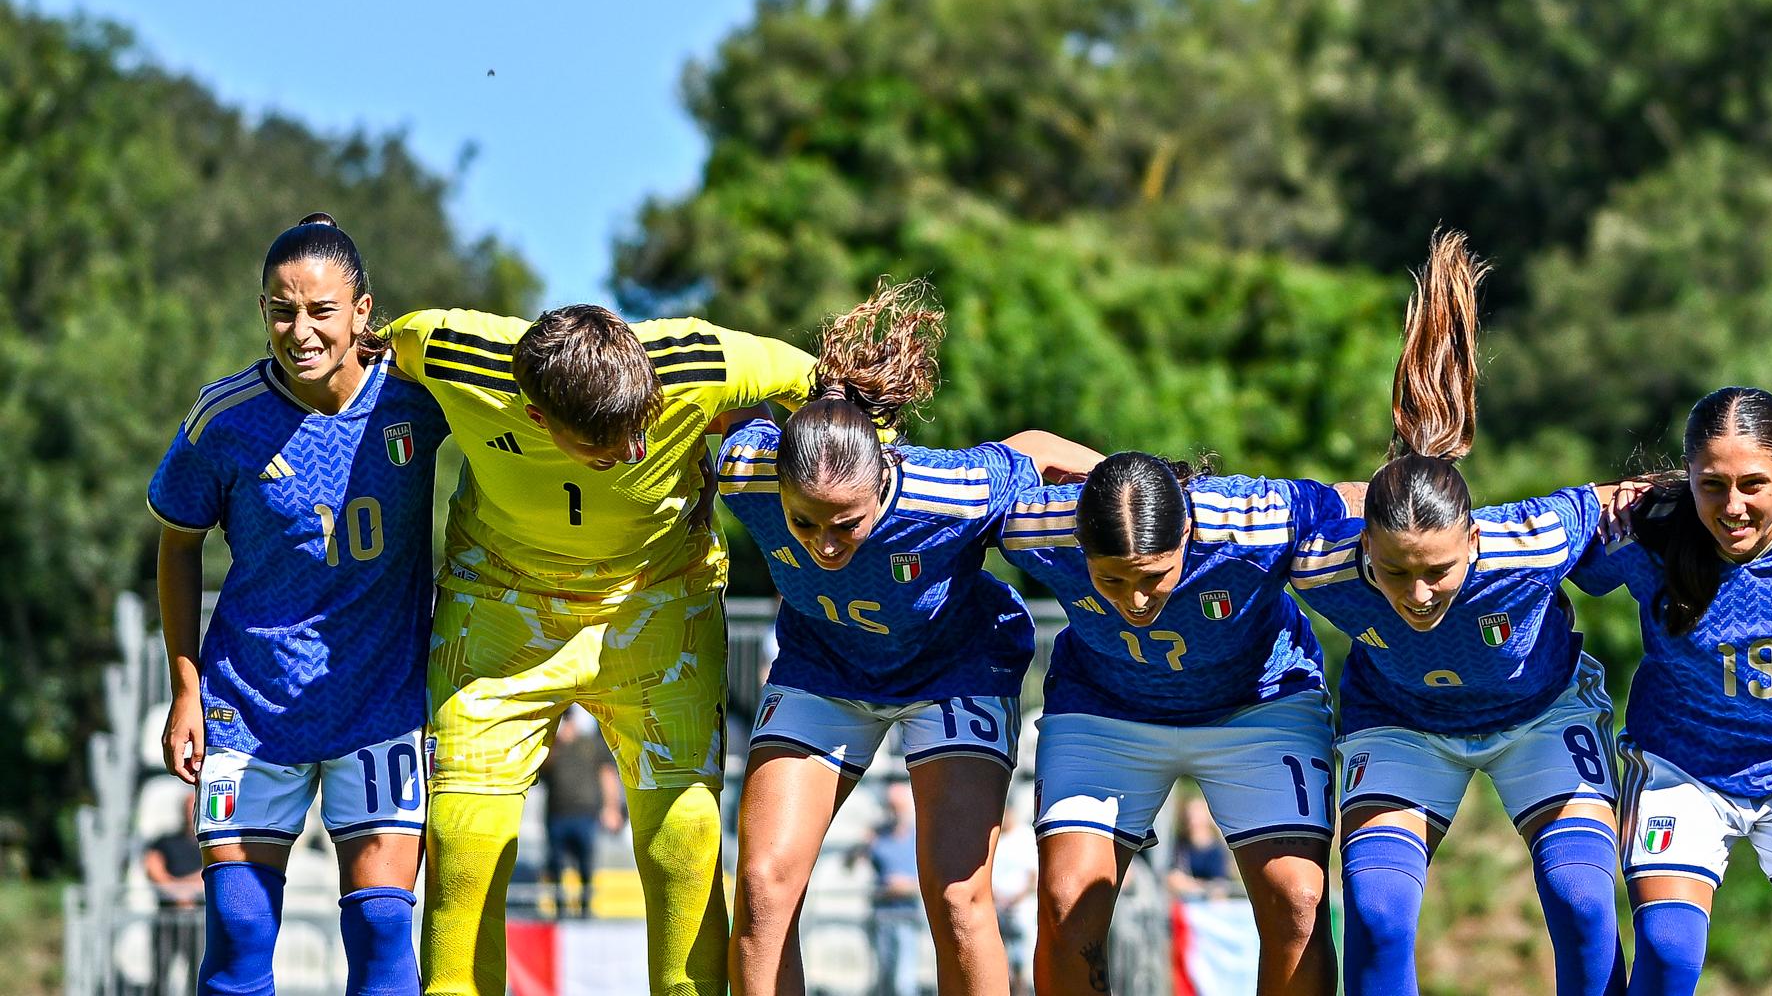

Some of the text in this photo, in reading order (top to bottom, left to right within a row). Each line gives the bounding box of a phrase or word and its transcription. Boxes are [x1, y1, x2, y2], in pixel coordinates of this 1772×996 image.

[386, 426, 409, 438] ITALIA
[563, 482, 582, 525] 1
[314, 497, 384, 566] 10
[893, 555, 917, 563] ITALIA
[1202, 592, 1226, 601] ITALIA
[1482, 615, 1506, 625] ITALIA
[1120, 630, 1187, 671] 17
[937, 697, 999, 742] 15
[1563, 725, 1605, 784] 8
[211, 783, 233, 792] ITALIA
[357, 742, 421, 814] 10
[1281, 755, 1333, 824] 17
[1649, 819, 1672, 827] ITALIA
